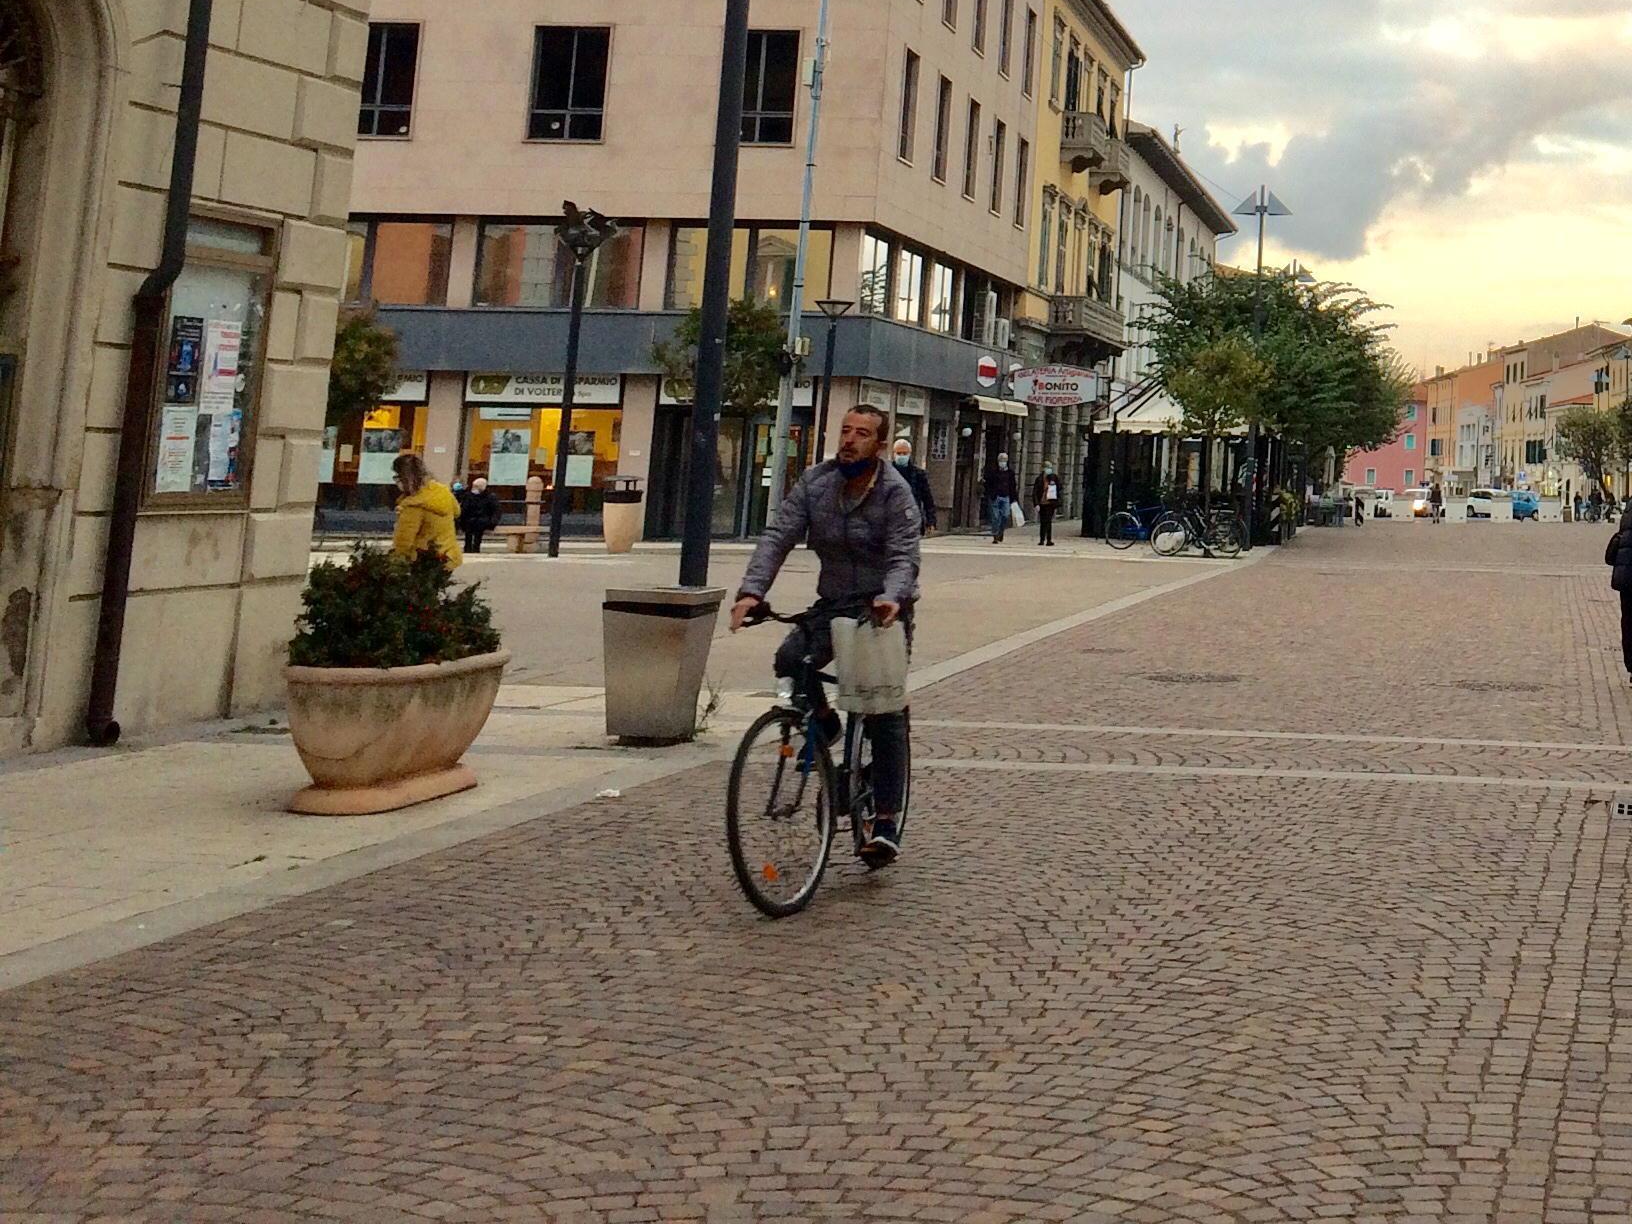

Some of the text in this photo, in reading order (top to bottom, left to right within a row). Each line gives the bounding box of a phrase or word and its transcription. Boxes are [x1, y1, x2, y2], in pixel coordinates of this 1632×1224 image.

[515, 375, 617, 385] CASSA DI SPARMIO
[1038, 382, 1079, 391] BONITO
[514, 387, 524, 396] DI
[527, 387, 568, 396] VOLTER
[1027, 395, 1043, 403] BAR
